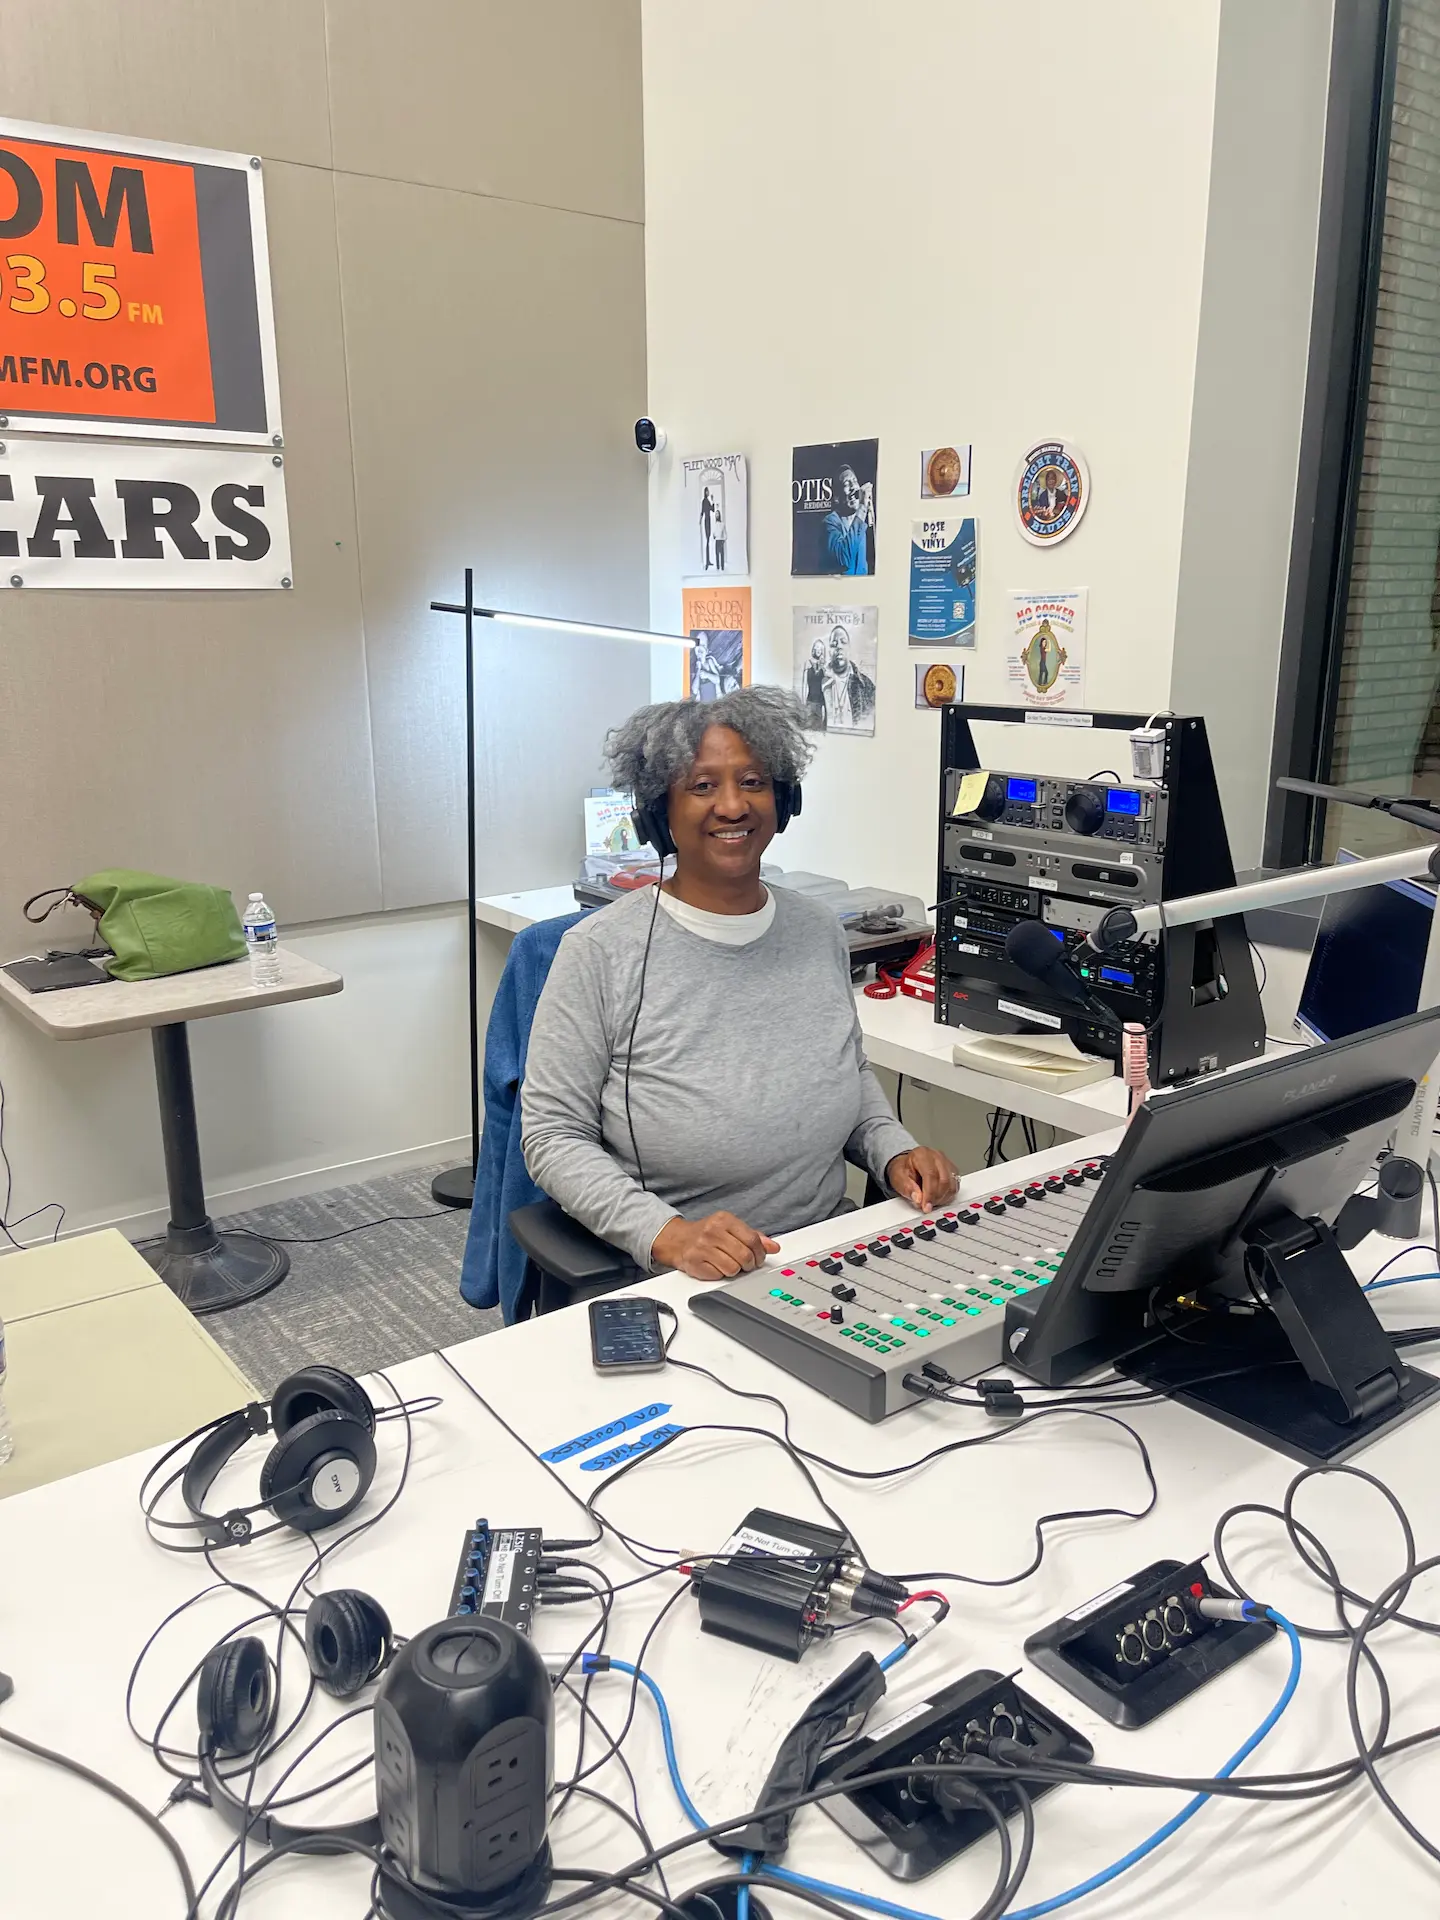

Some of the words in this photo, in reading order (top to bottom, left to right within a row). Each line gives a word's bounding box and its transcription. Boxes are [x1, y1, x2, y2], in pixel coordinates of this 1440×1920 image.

[127, 302, 163, 325] FM
[1056, 456, 1079, 493] TRAIN
[792, 478, 833, 503] OTIS
[804, 501, 832, 510] REDDING
[923, 521, 945, 533] DOSE
[1031, 510, 1072, 534] BLUES
[921, 538, 946, 549] VINYL
[953, 991, 969, 1001] APC
[633, 1406, 660, 1420] On
[652, 1427, 675, 1441] No
[331, 1474, 343, 1493] AKG
[741, 1532, 753, 1541] Do
[754, 1536, 770, 1546] Not
[772, 1542, 790, 1553] Turn
[791, 1549, 806, 1557] Off
[498, 1553, 508, 1562] Do
[495, 1562, 505, 1576] Not
[494, 1575, 505, 1589] Turn
[492, 1589, 502, 1600] Off
